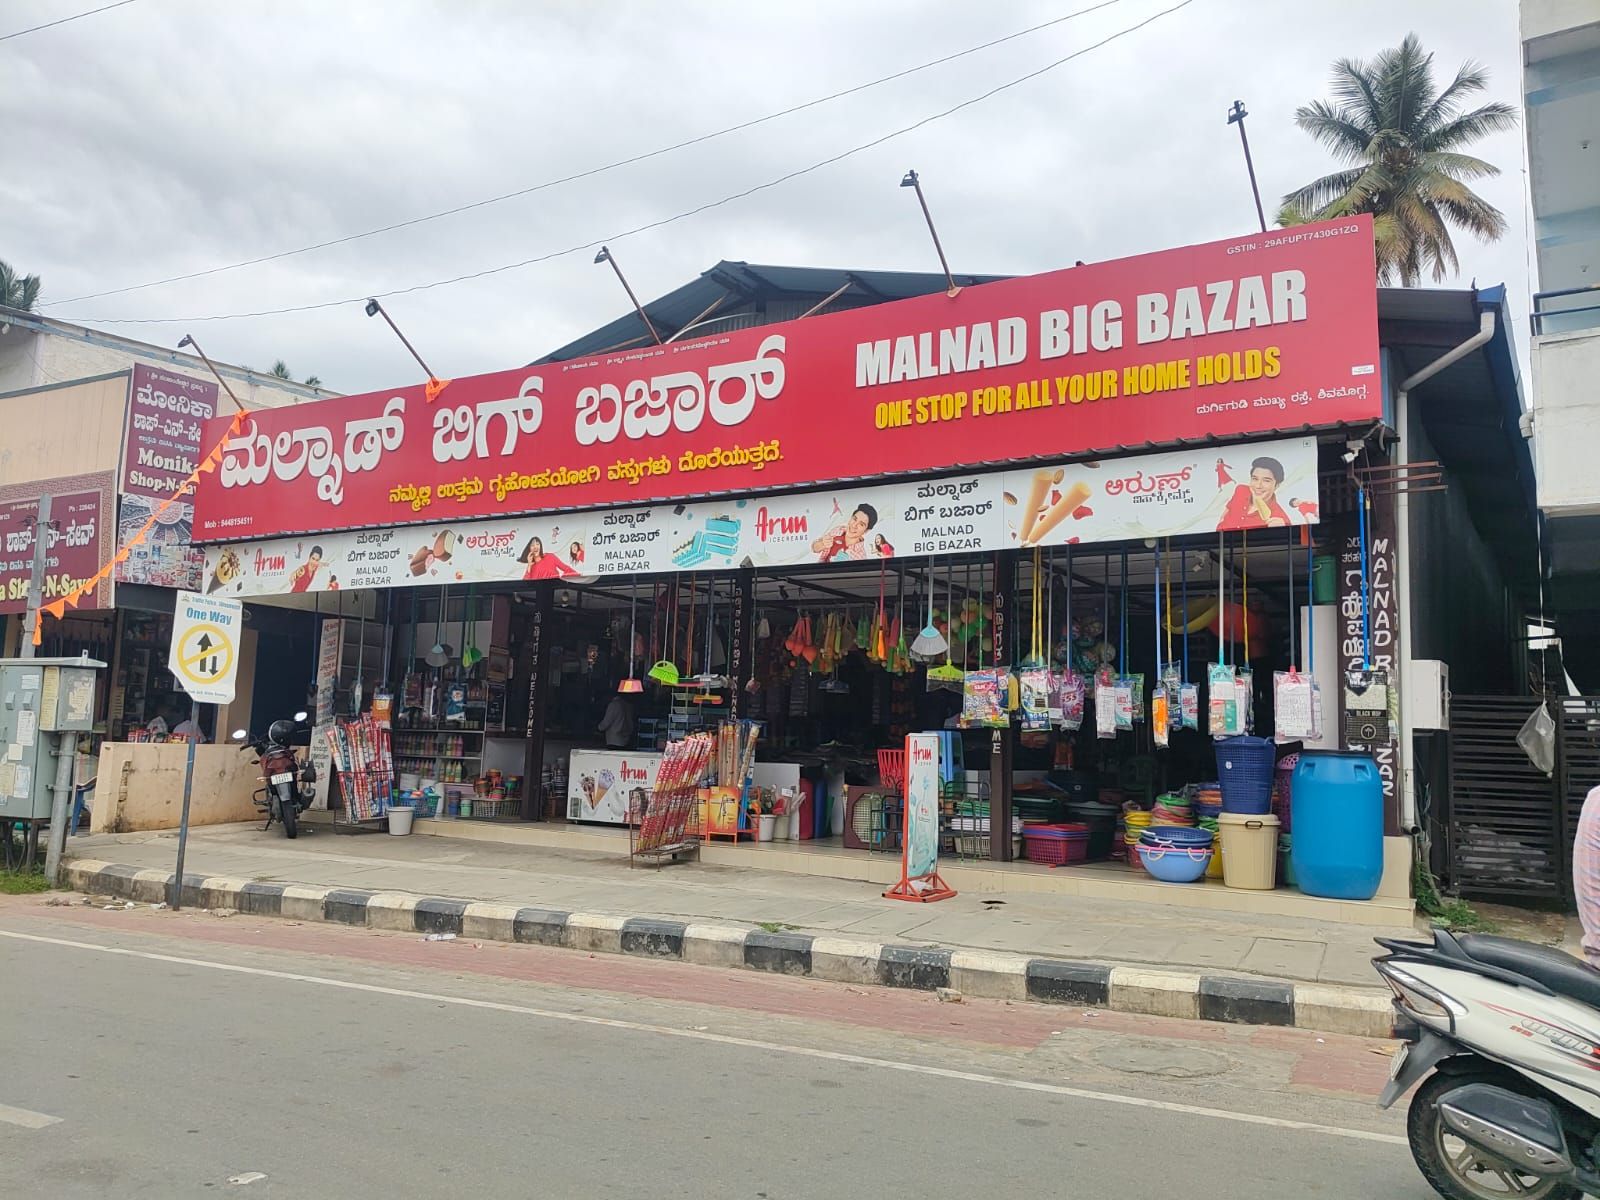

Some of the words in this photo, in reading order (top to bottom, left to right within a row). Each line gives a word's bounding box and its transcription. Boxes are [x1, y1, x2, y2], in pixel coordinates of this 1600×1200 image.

[1227, 243, 1256, 255] GSTIN
[855, 317, 1027, 388] MALNAD
[1040, 300, 1123, 360] BIG
[1136, 269, 1308, 344] BAZAR
[875, 400, 913, 430] ONE
[916, 391, 968, 425] STOP
[972, 386, 1013, 419] FOR
[1016, 378, 1051, 411] ALL
[1055, 368, 1118, 405] YOUR
[1123, 360, 1191, 394] HOME
[1197, 346, 1281, 387] HOLDS
[136, 384, 213, 420] ಮೋನಿಕಾ
[220, 397, 406, 506] ಮಲ್ನಾಡ್
[432, 375, 544, 463] ಬಿಗ್
[575, 334, 786, 446] ಬಜಾರ್
[138, 447, 198, 475] Monik
[389, 483, 432, 512] ನಮ್ಮಲ್ಲಿ
[437, 477, 484, 502] ಉತ್ತಮ
[607, 454, 672, 485] ವಸ್ತುಗಳು
[917, 479, 979, 501] ಮಲ್ನಾಡ್
[1105, 466, 1193, 496] ಅರುಣ್
[603, 510, 652, 528] ಮಲ್ನಾಡ್
[904, 505, 935, 521] ಬಿಗ್
[939, 500, 993, 518] ಬಜಾರ್
[754, 506, 808, 542] Arun
[921, 524, 974, 538] MALNAD
[466, 530, 517, 549] ಅರುಣ್
[592, 532, 616, 545] ಬಿಗ್
[619, 529, 660, 543] ಬಜಾರ್
[914, 541, 935, 553] BIG
[938, 538, 982, 551] BAZAR
[254, 548, 286, 576] Arun
[604, 549, 645, 560] MALNAD
[356, 565, 388, 575] MALNAD
[598, 563, 615, 573] BIG
[617, 561, 650, 571] BAZAR
[350, 578, 364, 587] BIG
[366, 576, 392, 585] BAZAR
[1372, 538, 1392, 647] MALNAD
[186, 607, 207, 621] One
[210, 610, 232, 626] Way
[913, 739, 932, 765] Arun
[619, 760, 648, 782] Arun
